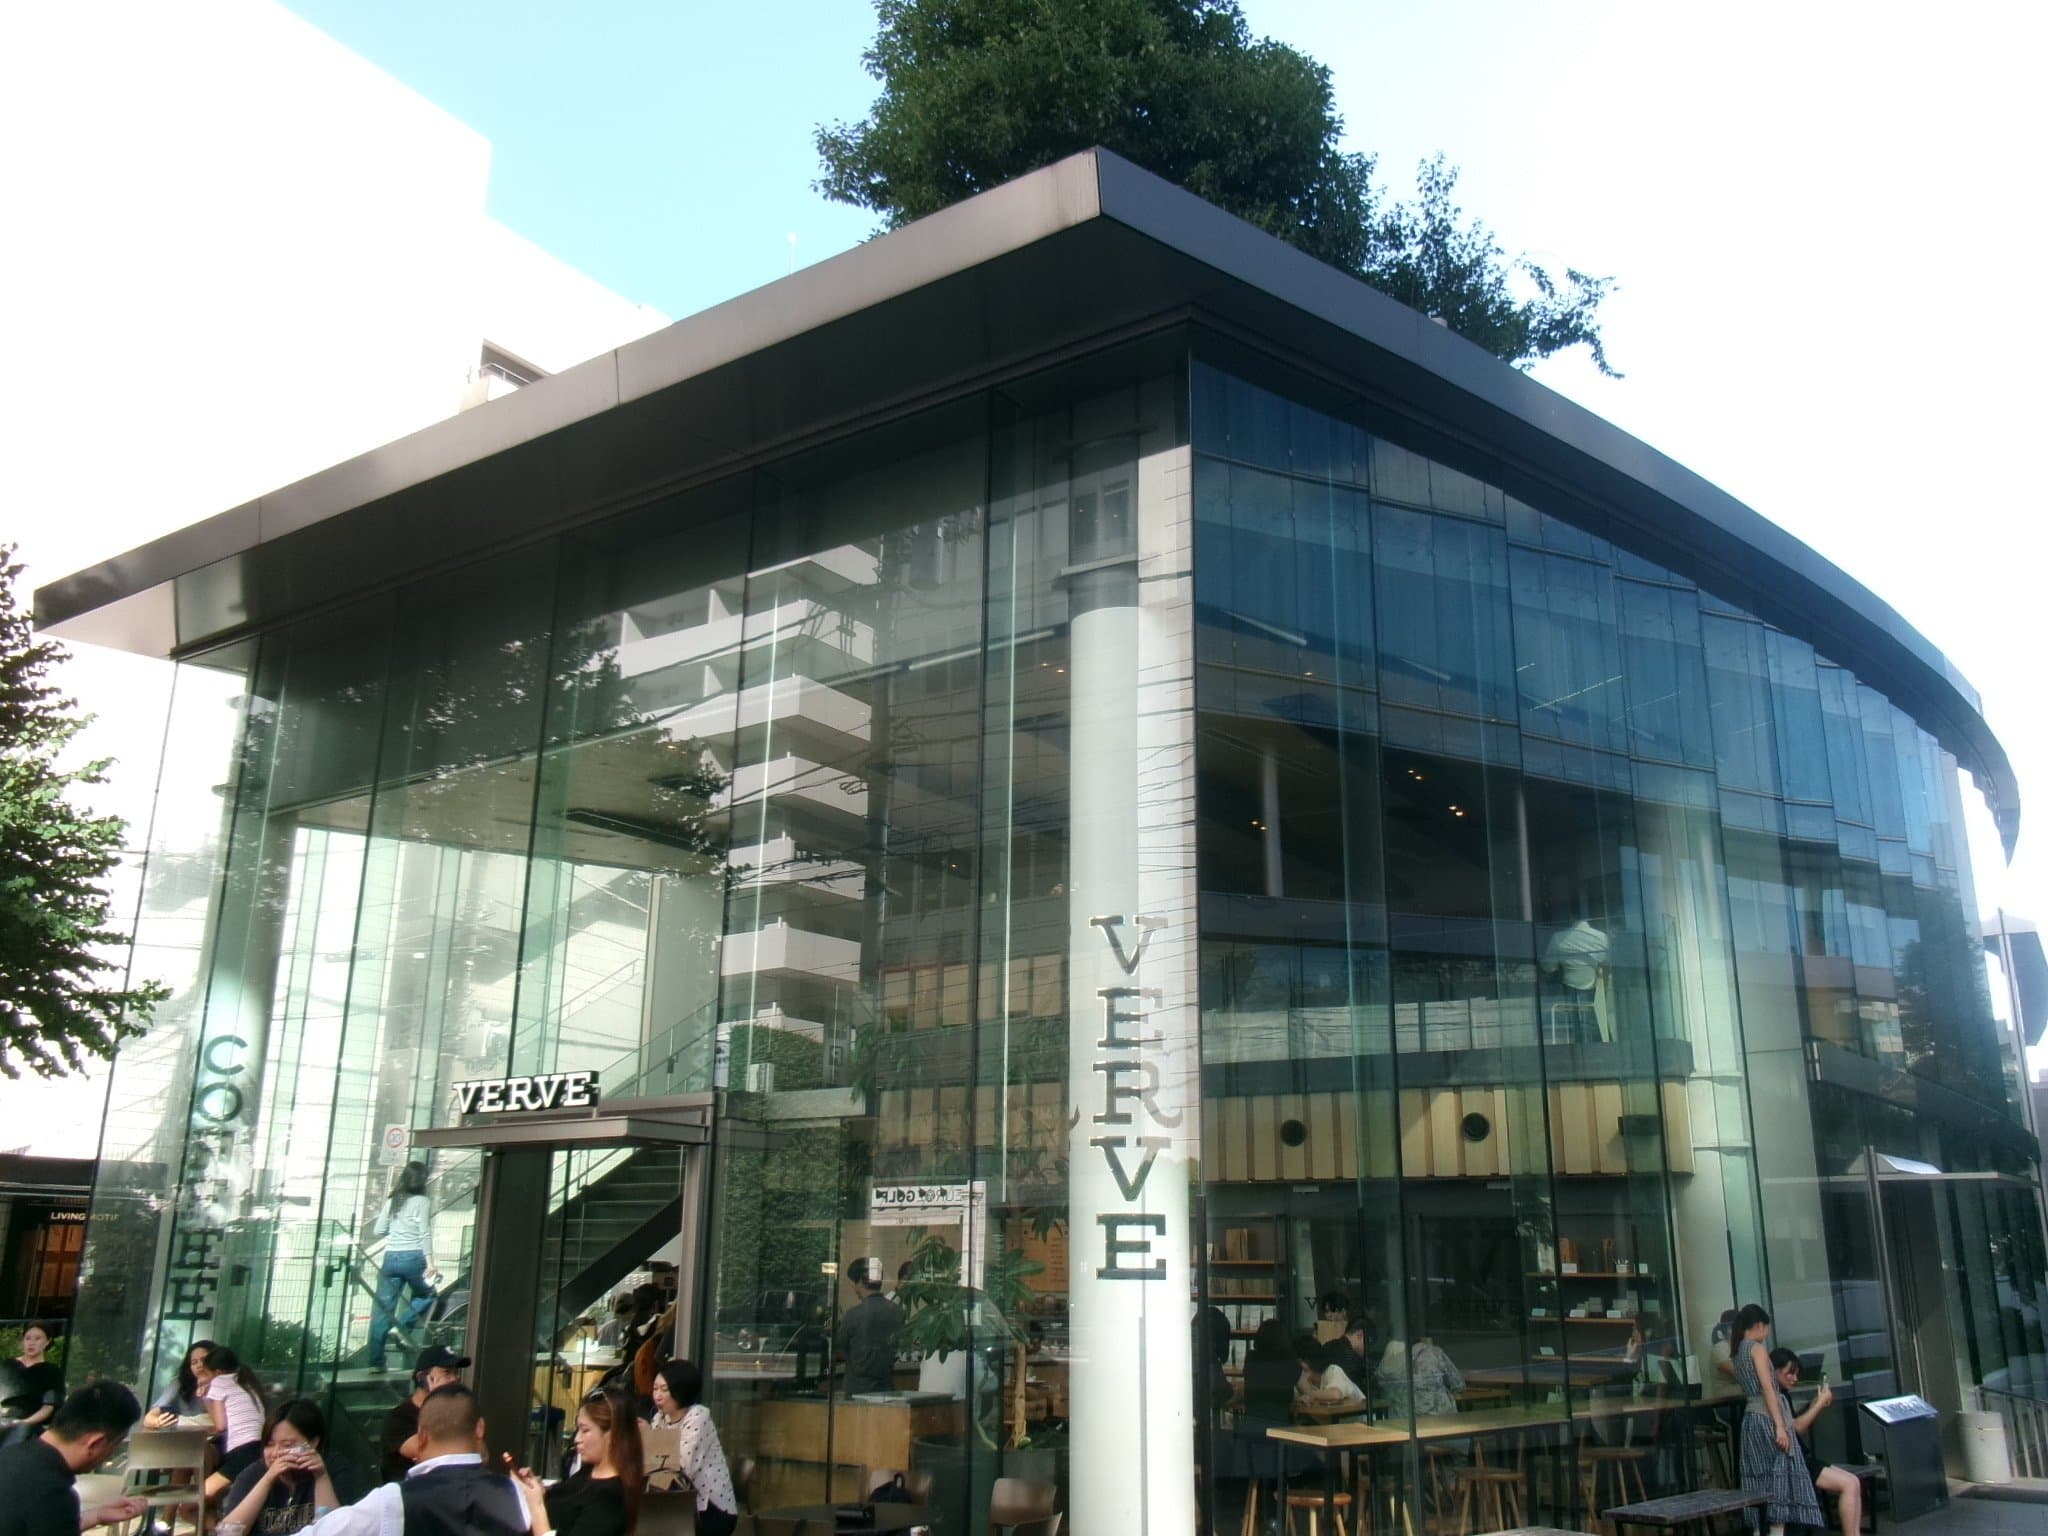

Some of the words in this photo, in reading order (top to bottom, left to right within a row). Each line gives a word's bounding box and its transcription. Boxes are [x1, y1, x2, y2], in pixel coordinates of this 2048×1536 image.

[453, 1071, 596, 1114] VERVE
[1089, 915, 1183, 1281] VERVE
[51, 1212, 86, 1221] LIVING
